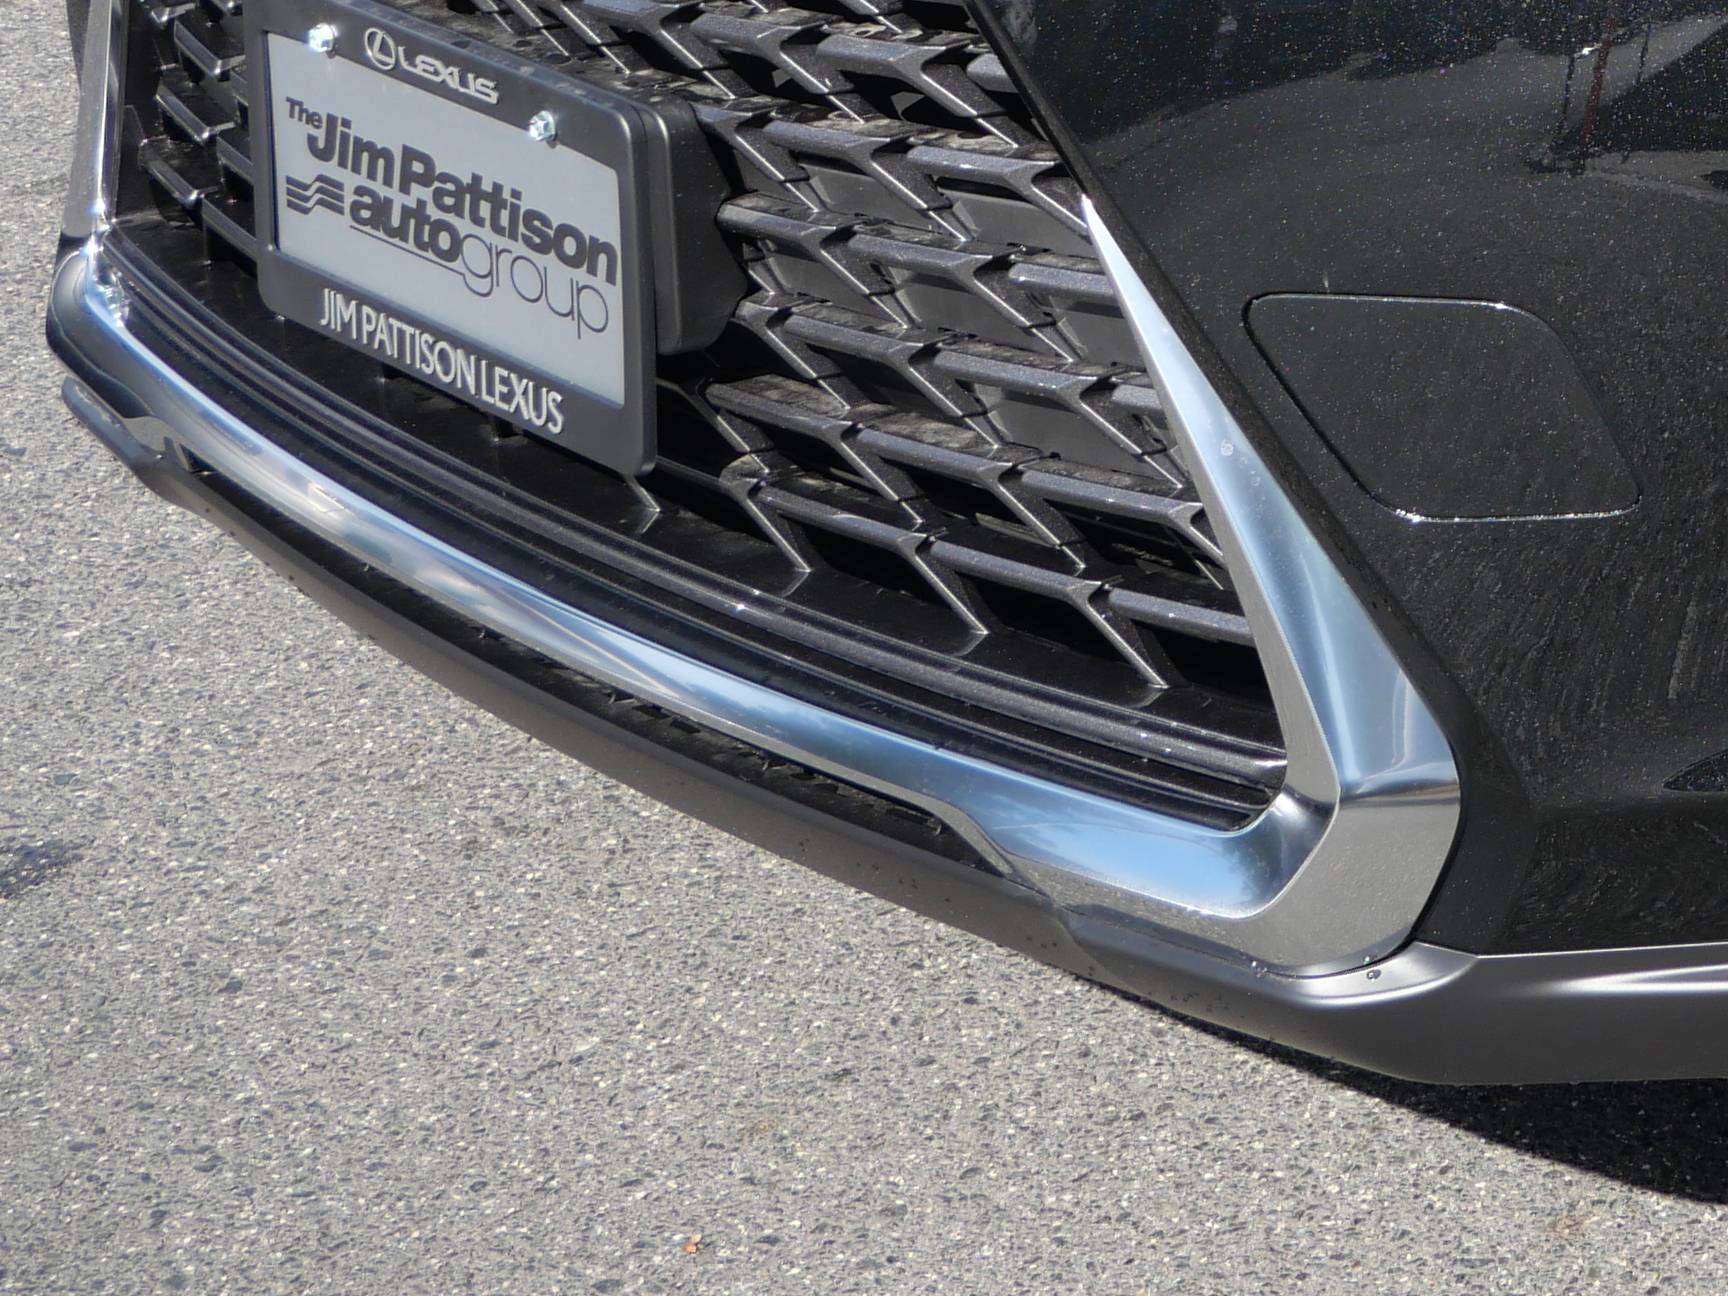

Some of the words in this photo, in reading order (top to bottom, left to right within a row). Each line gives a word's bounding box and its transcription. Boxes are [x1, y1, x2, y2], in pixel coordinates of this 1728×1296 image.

[286, 96, 323, 130] The
[397, 45, 500, 105] LEXUS
[306, 112, 396, 189] Jim
[399, 144, 618, 286] Pattison
[320, 288, 359, 340] JIM
[362, 305, 477, 397] PATTISON
[480, 360, 565, 435] LEXUS
